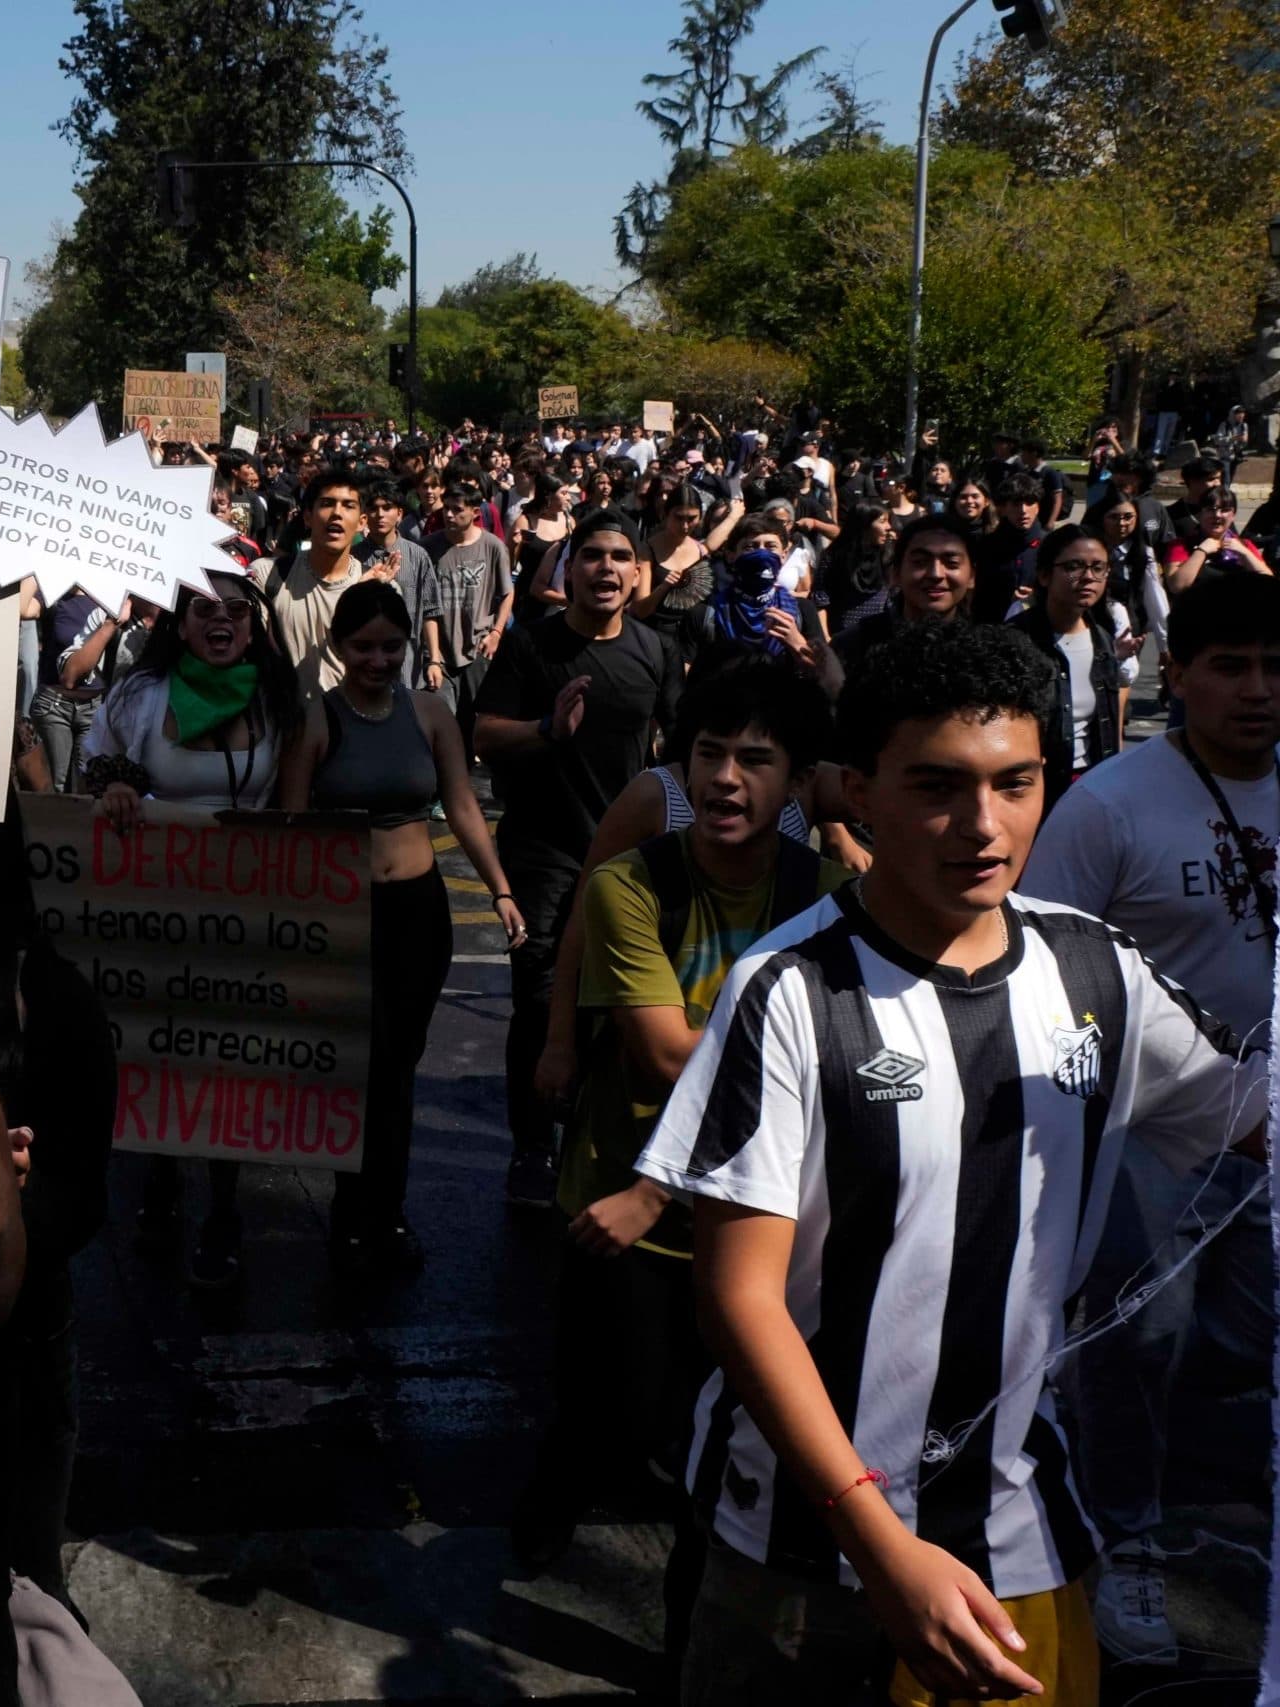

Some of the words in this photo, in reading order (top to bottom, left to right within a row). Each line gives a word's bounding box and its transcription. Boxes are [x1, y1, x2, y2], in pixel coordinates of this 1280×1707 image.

[76, 473, 109, 495] NO
[115, 484, 194, 520] VAMOS
[80, 500, 167, 538] NINGÚN
[44, 538, 81, 561] DÍA
[88, 553, 167, 587] EXISTA
[78, 525, 162, 561] SOCIAL
[91, 816, 361, 905] DERECHOS
[197, 913, 245, 946] no
[267, 911, 329, 955] los
[92, 956, 146, 999] los
[113, 1057, 361, 1155] RIVILEGIOS
[865, 1084, 921, 1101] umbro
